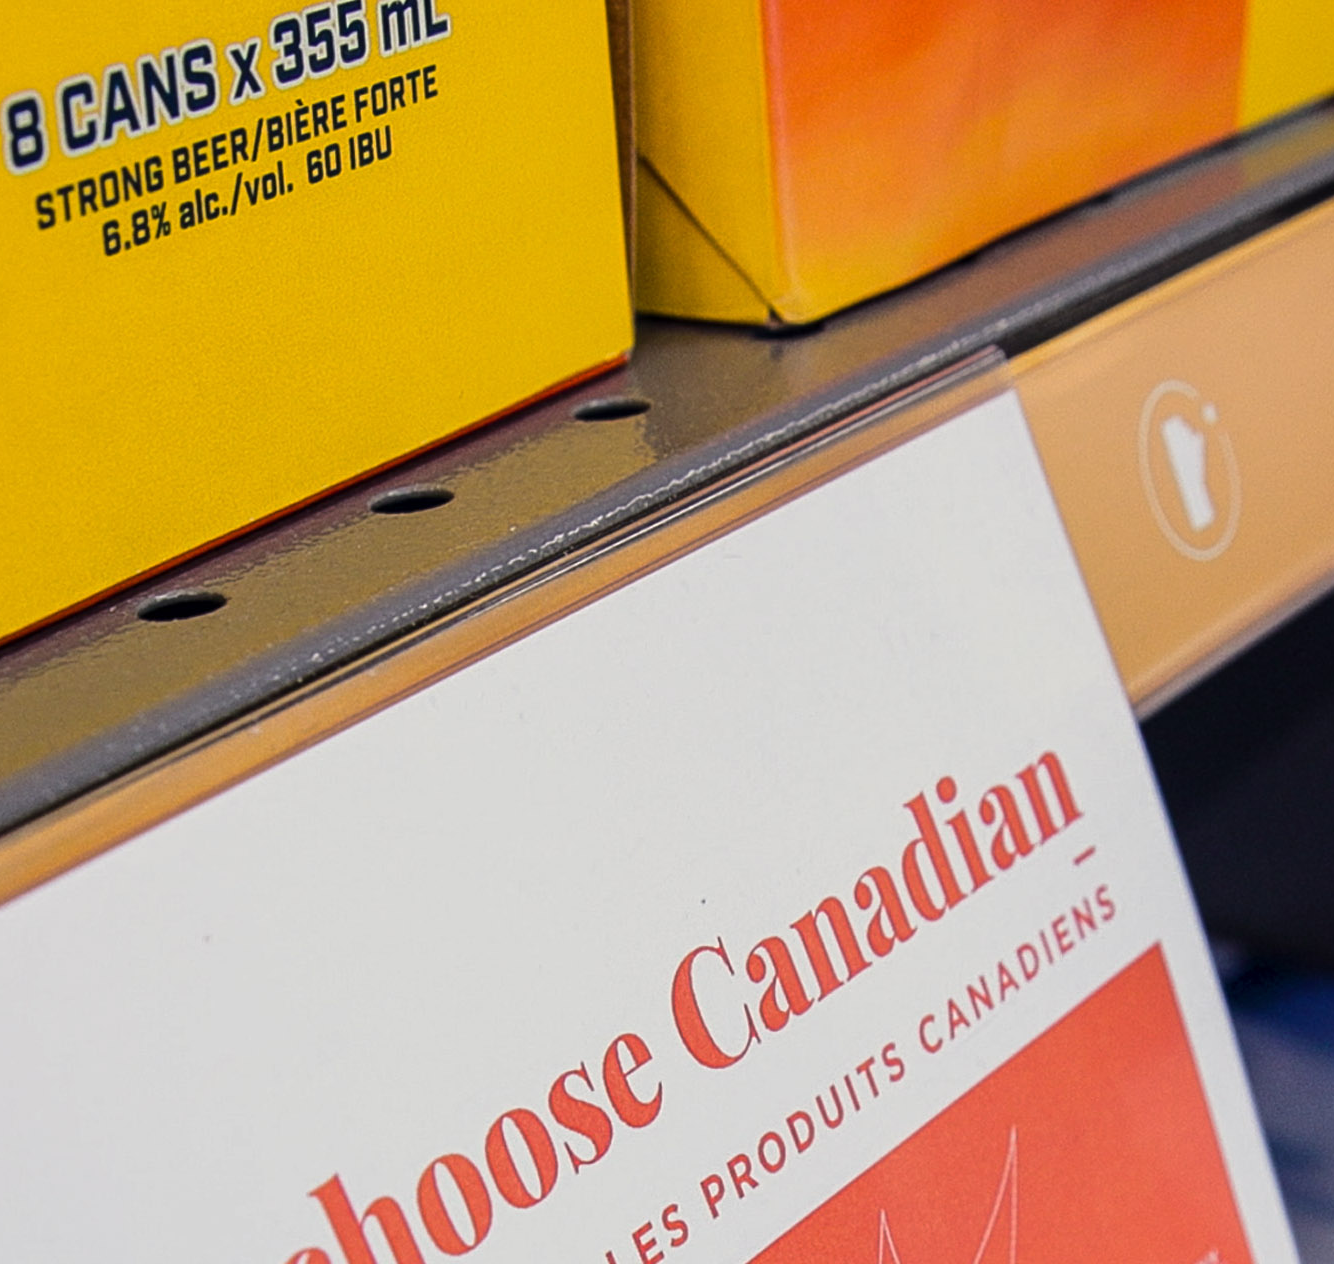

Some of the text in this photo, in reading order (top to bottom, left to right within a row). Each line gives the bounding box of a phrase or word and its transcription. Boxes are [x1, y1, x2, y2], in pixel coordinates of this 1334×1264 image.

[3, 0, 450, 172] 8 CANS x 355 mL
[36, 64, 438, 230] STRONG BEER/BIÈRE FORTE
[102, 125, 392, 257] 6.8% alc./vol. 60 IBU
[670, 750, 1083, 1070] Canadian
[700, 1043, 905, 1218] PRODUITS
[919, 884, 1118, 1055] CANADIENS
